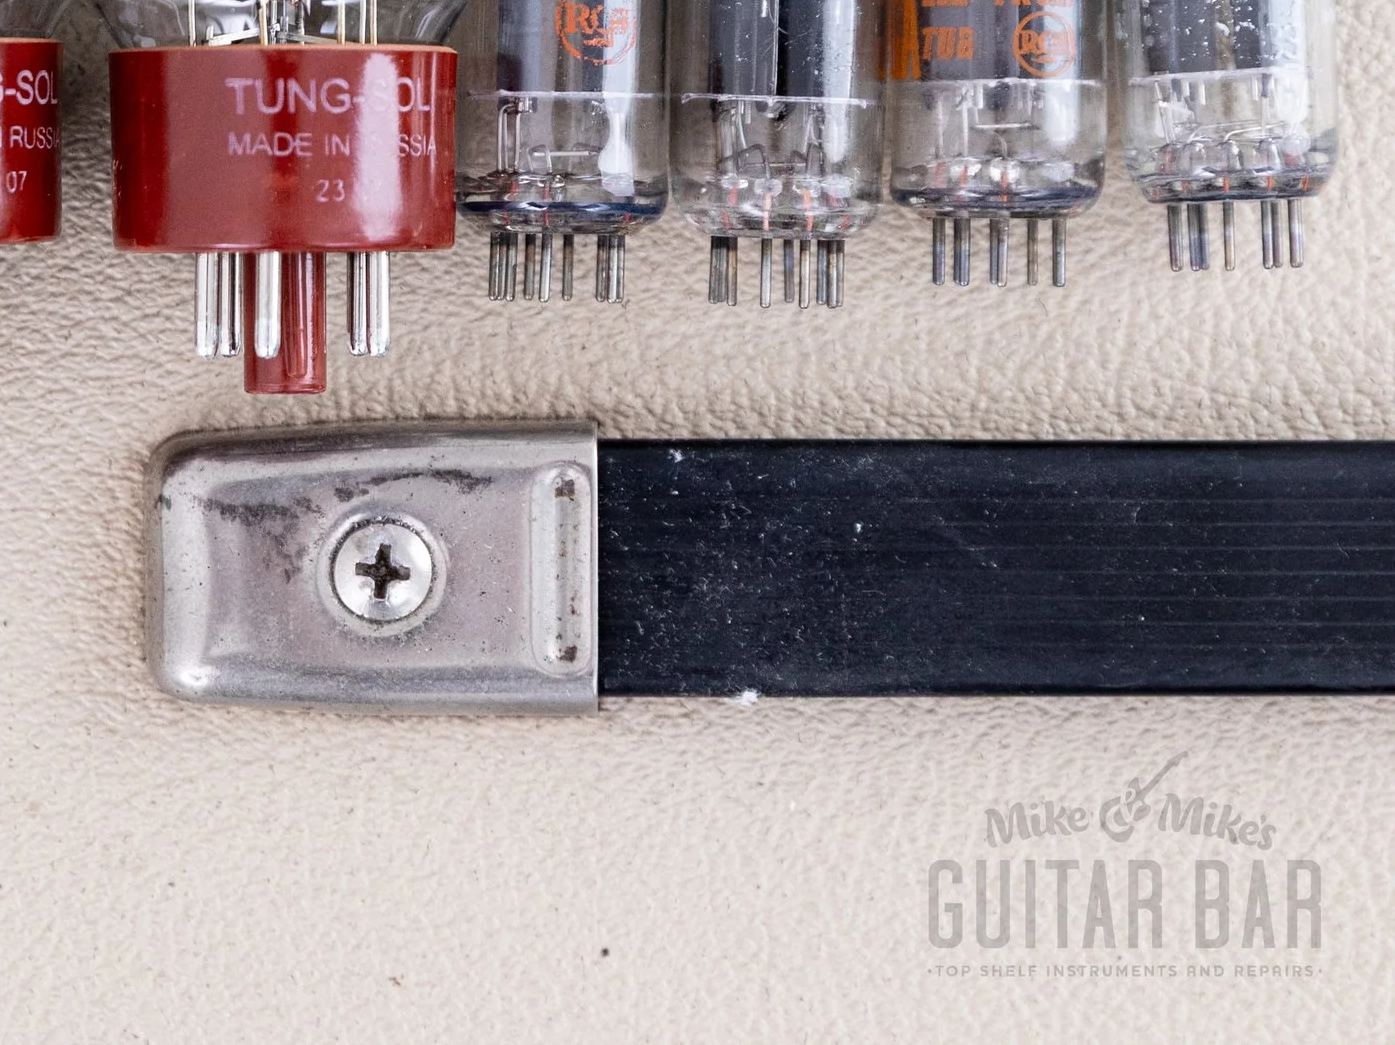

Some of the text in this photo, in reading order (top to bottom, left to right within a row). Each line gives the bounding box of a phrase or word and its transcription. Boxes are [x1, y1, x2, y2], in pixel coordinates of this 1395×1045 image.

[224, 77, 431, 115] TUNG-SOL
[227, 131, 313, 158] MADE
[324, 133, 351, 157] IN
[7, 170, 28, 194] 07
[315, 178, 346, 203] 23
